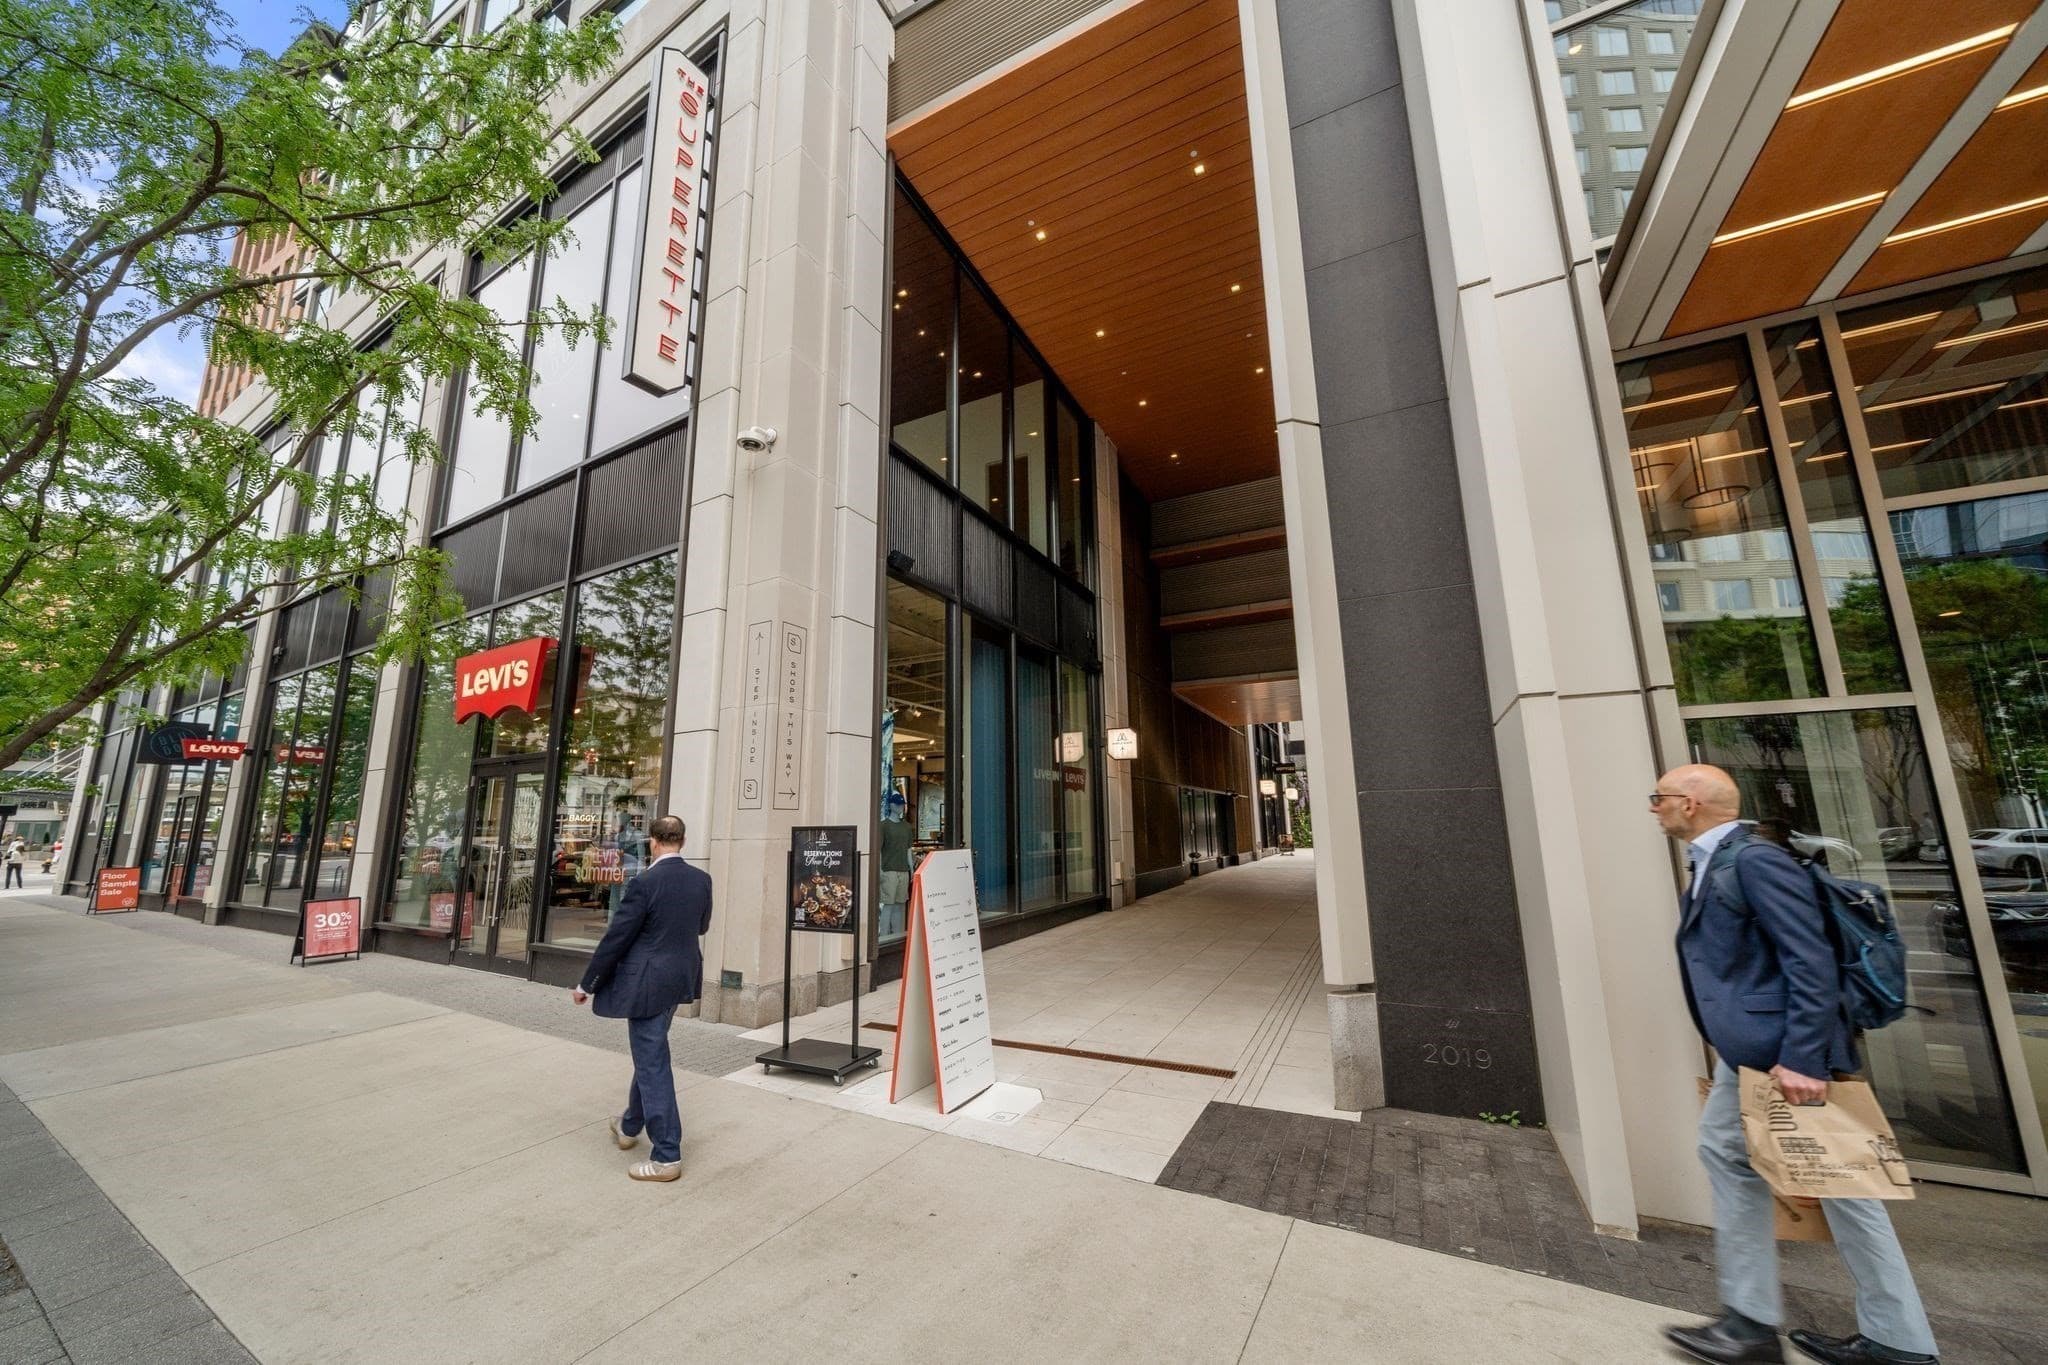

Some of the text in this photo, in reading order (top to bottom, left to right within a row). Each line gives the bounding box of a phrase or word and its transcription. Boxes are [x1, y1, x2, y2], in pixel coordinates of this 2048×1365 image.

[676, 67, 705, 96] THE
[659, 91, 699, 363] SUPERETTE
[750, 668, 761, 763] STEP INSIDE
[785, 661, 797, 778] SHOPS THIS WAY
[568, 814, 597, 822] BAGGY
[101, 880, 137, 888] Sample
[575, 865, 626, 882] summer
[100, 888, 122, 896] Sale
[314, 911, 353, 929] 30%
[1422, 1043, 1492, 1070] 2019
